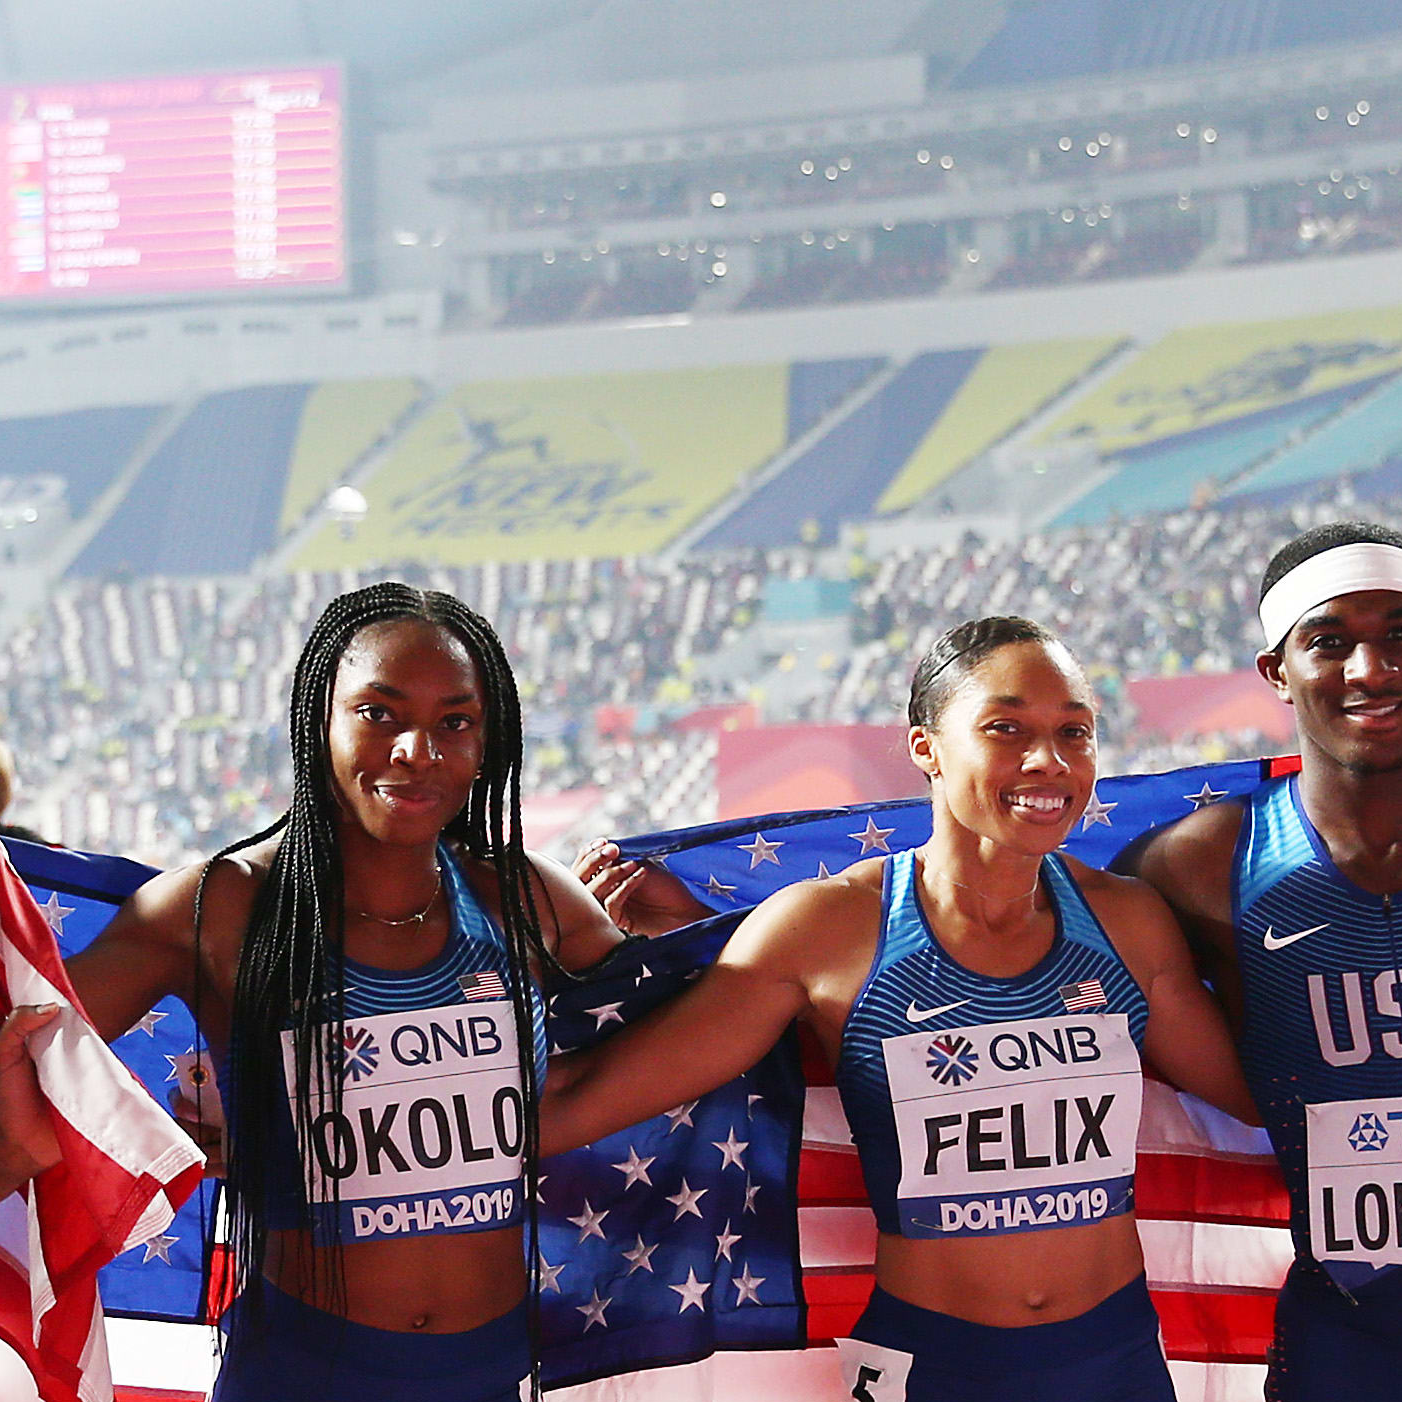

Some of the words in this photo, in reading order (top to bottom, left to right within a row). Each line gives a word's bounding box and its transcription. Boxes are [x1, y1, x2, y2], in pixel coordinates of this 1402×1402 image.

[391, 1016, 501, 1067] QNB
[989, 1026, 1101, 1072] QNB
[311, 1086, 523, 1180] OKOLO
[923, 1094, 1116, 1176] FELIX
[353, 1187, 514, 1238] DOHA2019
[940, 1187, 1108, 1233] DOHA2019
